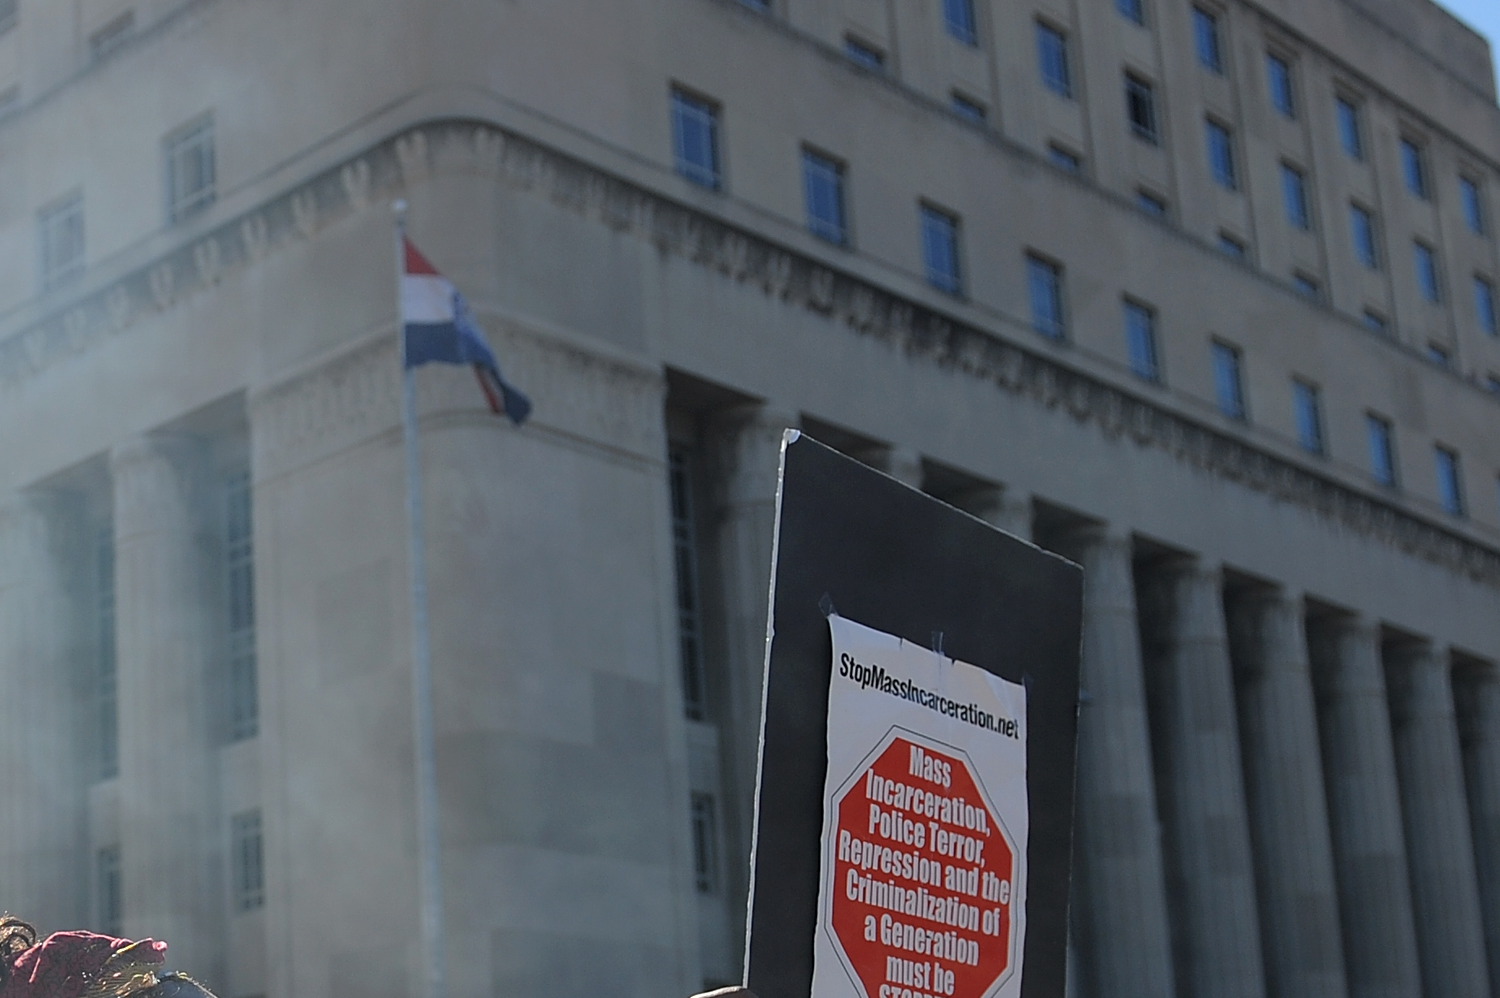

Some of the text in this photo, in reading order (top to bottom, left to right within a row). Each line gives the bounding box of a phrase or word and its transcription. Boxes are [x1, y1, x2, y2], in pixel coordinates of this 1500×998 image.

[839, 652, 1019, 739] StopMassIncarceration.net
[909, 745, 951, 788] Mass
[866, 768, 991, 838] Incarceration,
[868, 803, 985, 868] Police Terror,
[838, 829, 1010, 905] Repression and the
[846, 868, 1000, 936] Criminalization of
[864, 913, 979, 966] a Generation
[886, 956, 955, 996] must be
